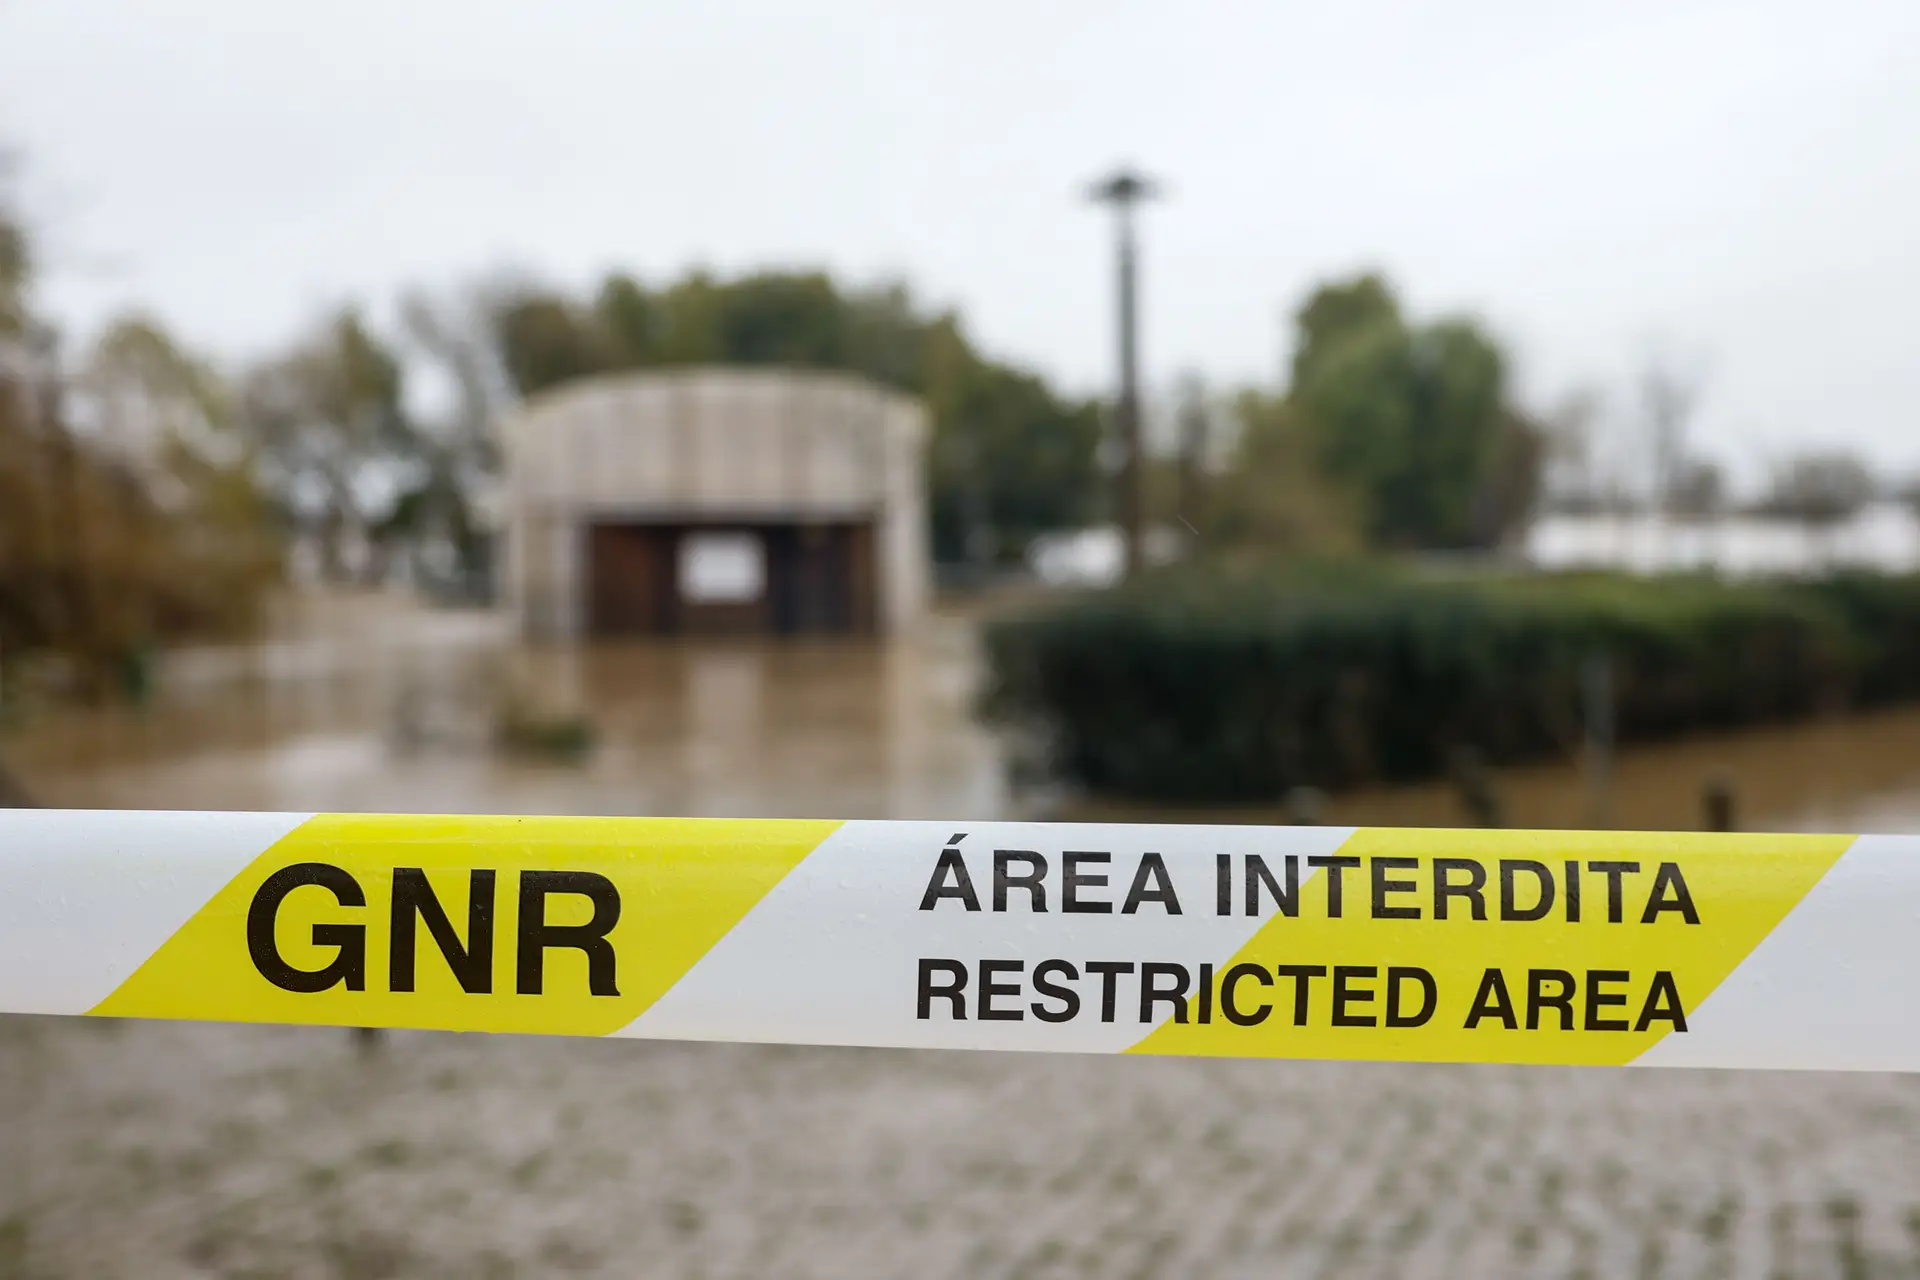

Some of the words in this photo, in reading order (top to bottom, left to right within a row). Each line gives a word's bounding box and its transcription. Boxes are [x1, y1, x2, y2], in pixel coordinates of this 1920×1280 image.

[918, 833, 1183, 916] ÁREA
[1216, 853, 1701, 925] INTERDITA
[246, 862, 621, 997] GNR
[916, 958, 1438, 1028] RESTRICTED
[1462, 968, 1689, 1033] AREA
